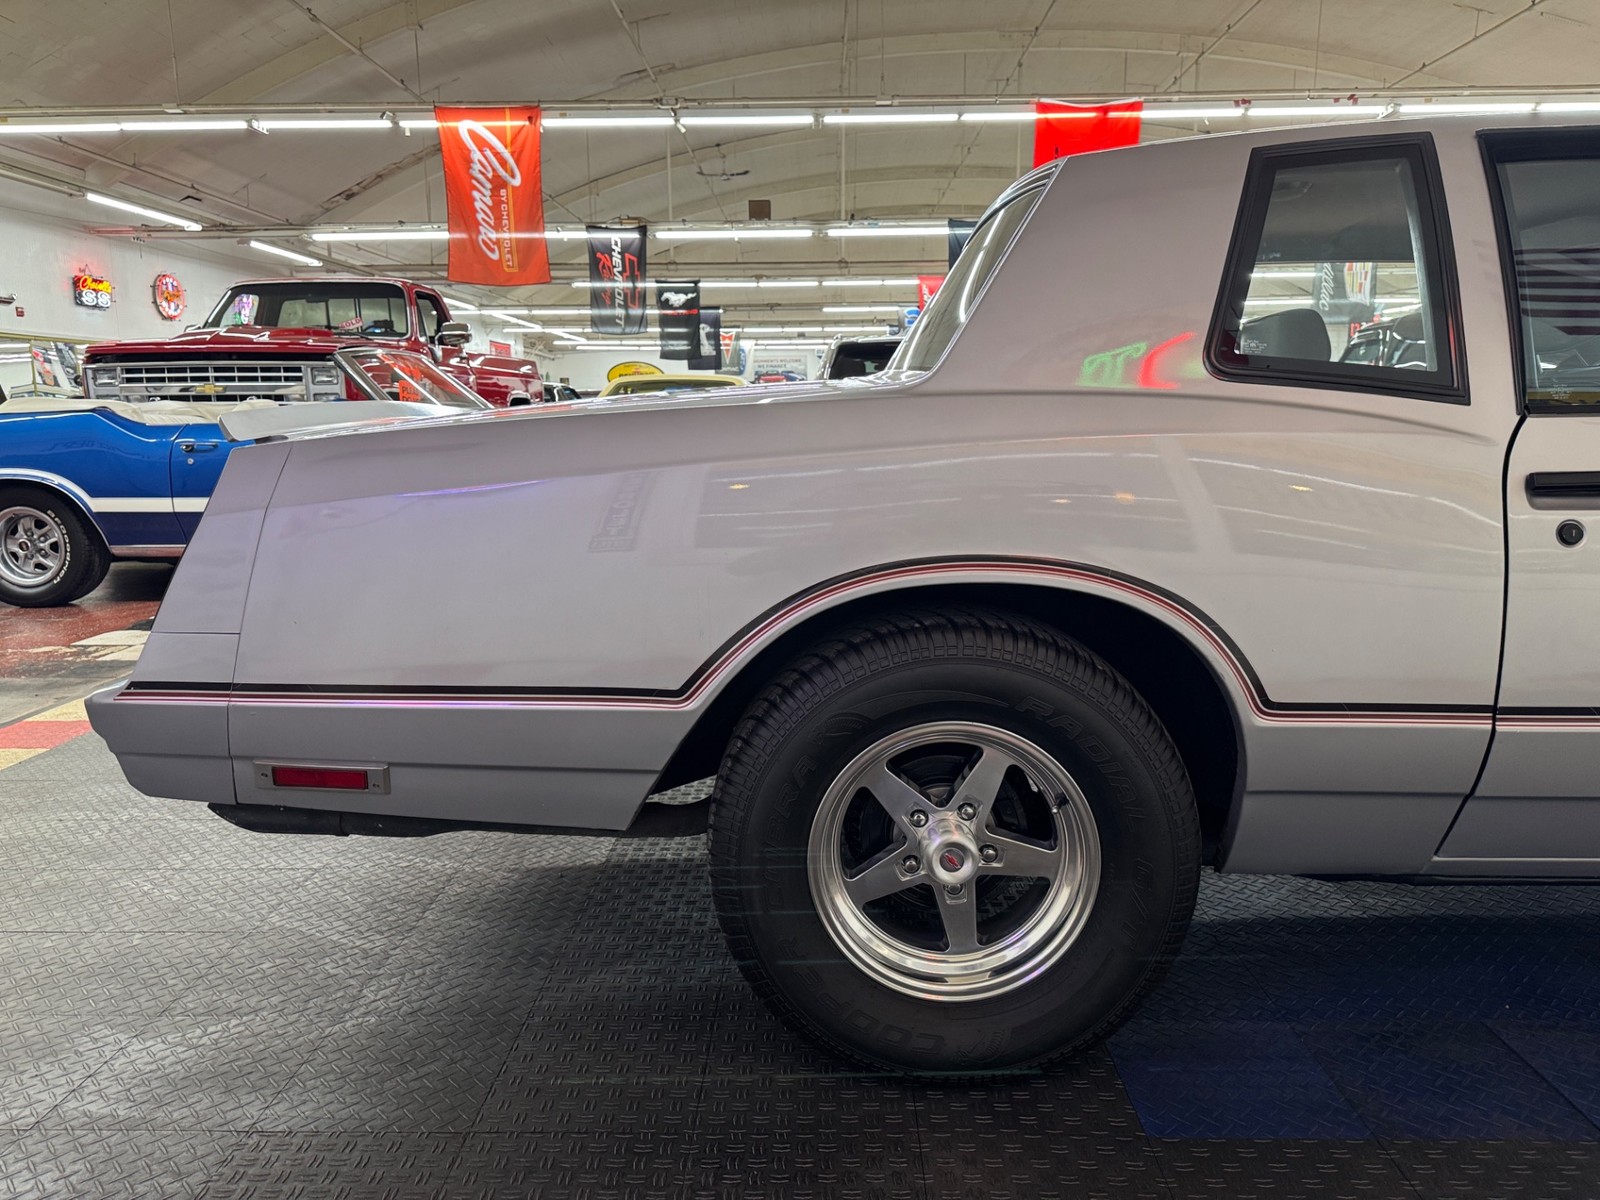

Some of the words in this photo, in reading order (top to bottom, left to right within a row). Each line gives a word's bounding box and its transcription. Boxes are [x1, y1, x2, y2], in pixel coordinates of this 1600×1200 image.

[458, 119, 521, 261] Camaro
[500, 189, 507, 202] BY
[501, 203, 513, 267] CHEVROLET
[81, 290, 111, 307] SS
[611, 234, 625, 328] CHEVROLET
[1015, 695, 1147, 833] RADIAL
[775, 935, 946, 1055] COOPER
